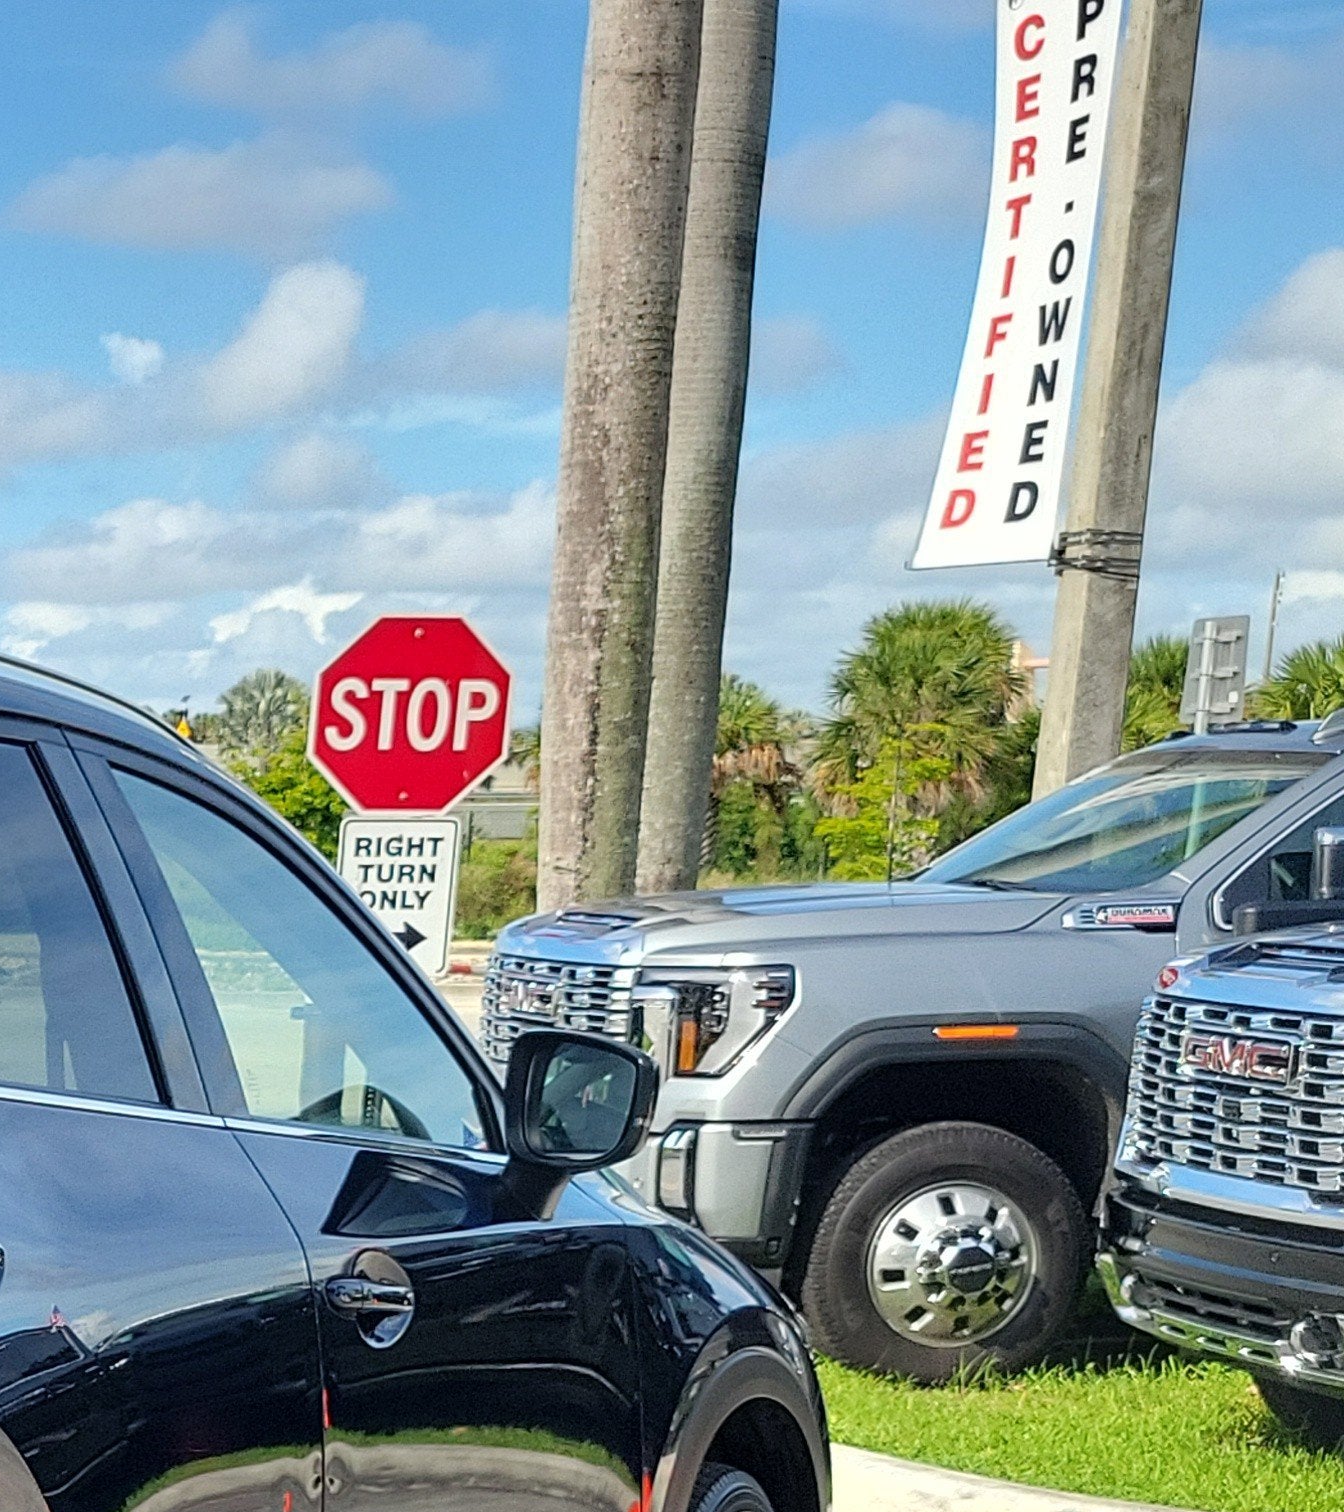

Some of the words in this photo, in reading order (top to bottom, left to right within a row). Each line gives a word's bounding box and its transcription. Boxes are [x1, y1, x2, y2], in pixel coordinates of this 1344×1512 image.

[938, 13, 1046, 530] CERTIFIED
[323, 676, 501, 752] STOP
[354, 836, 445, 858] RIGHT
[358, 863, 437, 884] TURN
[1183, 1034, 1290, 1083] GMC
